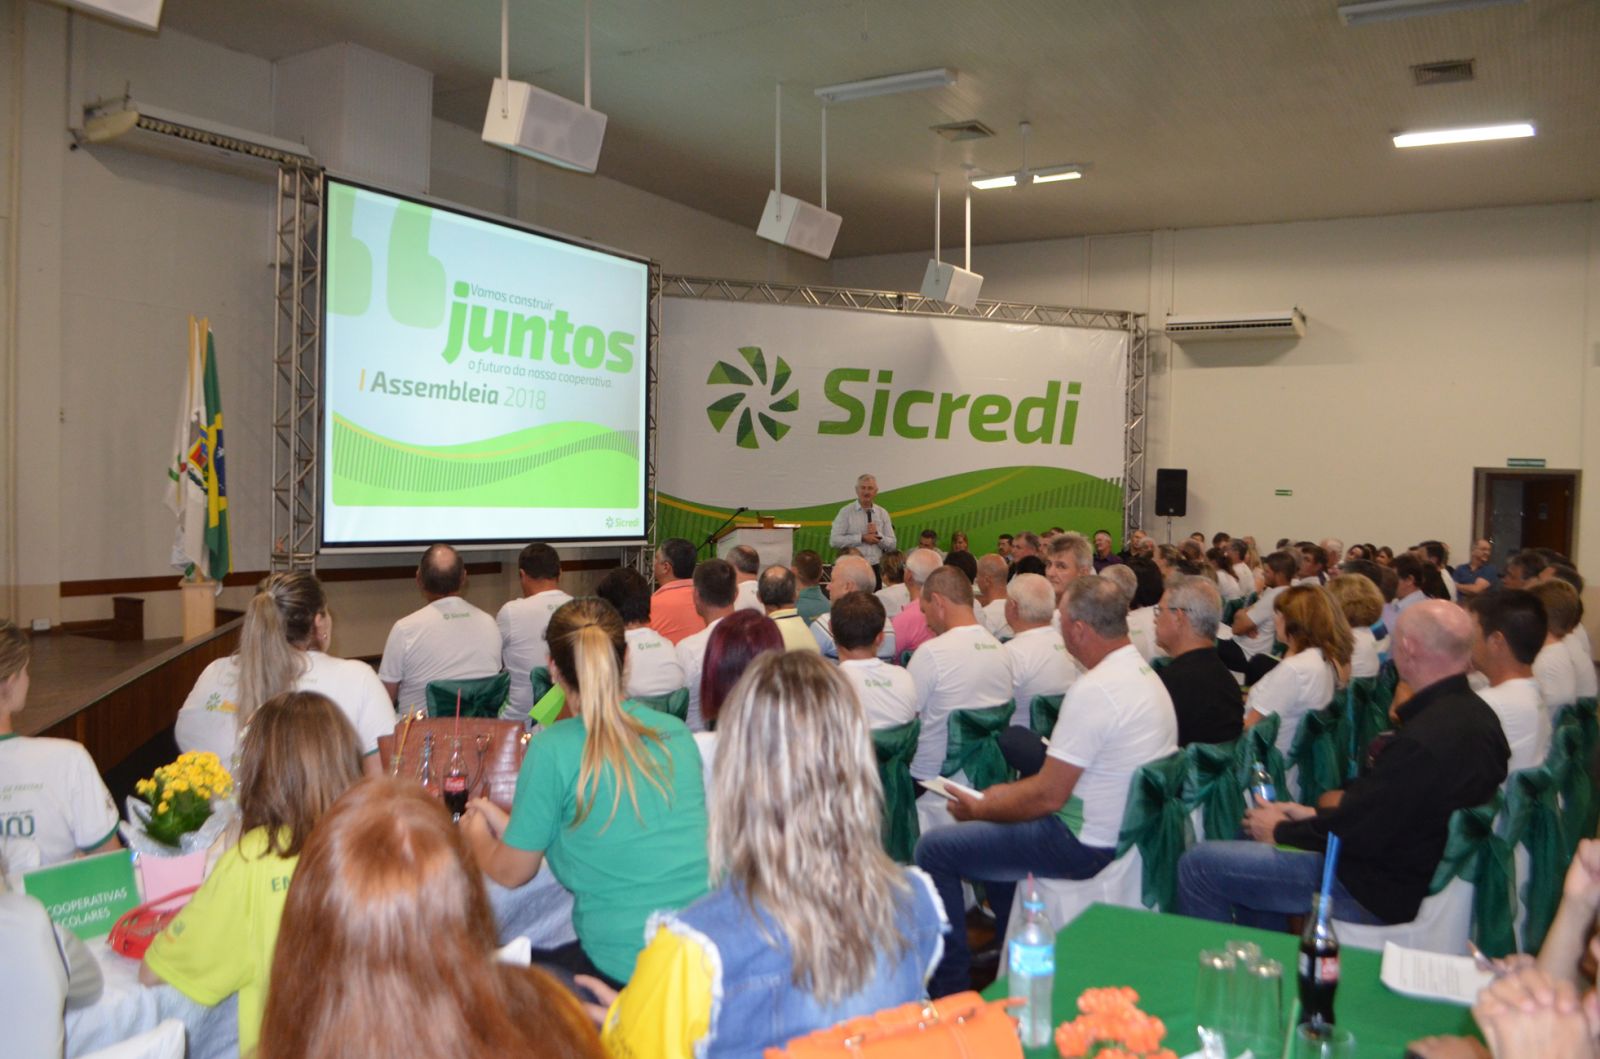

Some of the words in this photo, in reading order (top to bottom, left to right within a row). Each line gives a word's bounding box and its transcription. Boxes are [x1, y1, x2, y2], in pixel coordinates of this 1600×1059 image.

[471, 283, 508, 303] Vamos
[508, 293, 554, 311] construir
[441, 281, 636, 374] juntos
[476, 359, 511, 375] futuro
[512, 364, 526, 376] da
[527, 368, 557, 381] nossa
[370, 371, 499, 405] Assembleia
[503, 386, 547, 410] 2018
[817, 367, 1082, 446] Sicredi
[47, 886, 128, 917] COOPERATIVAS
